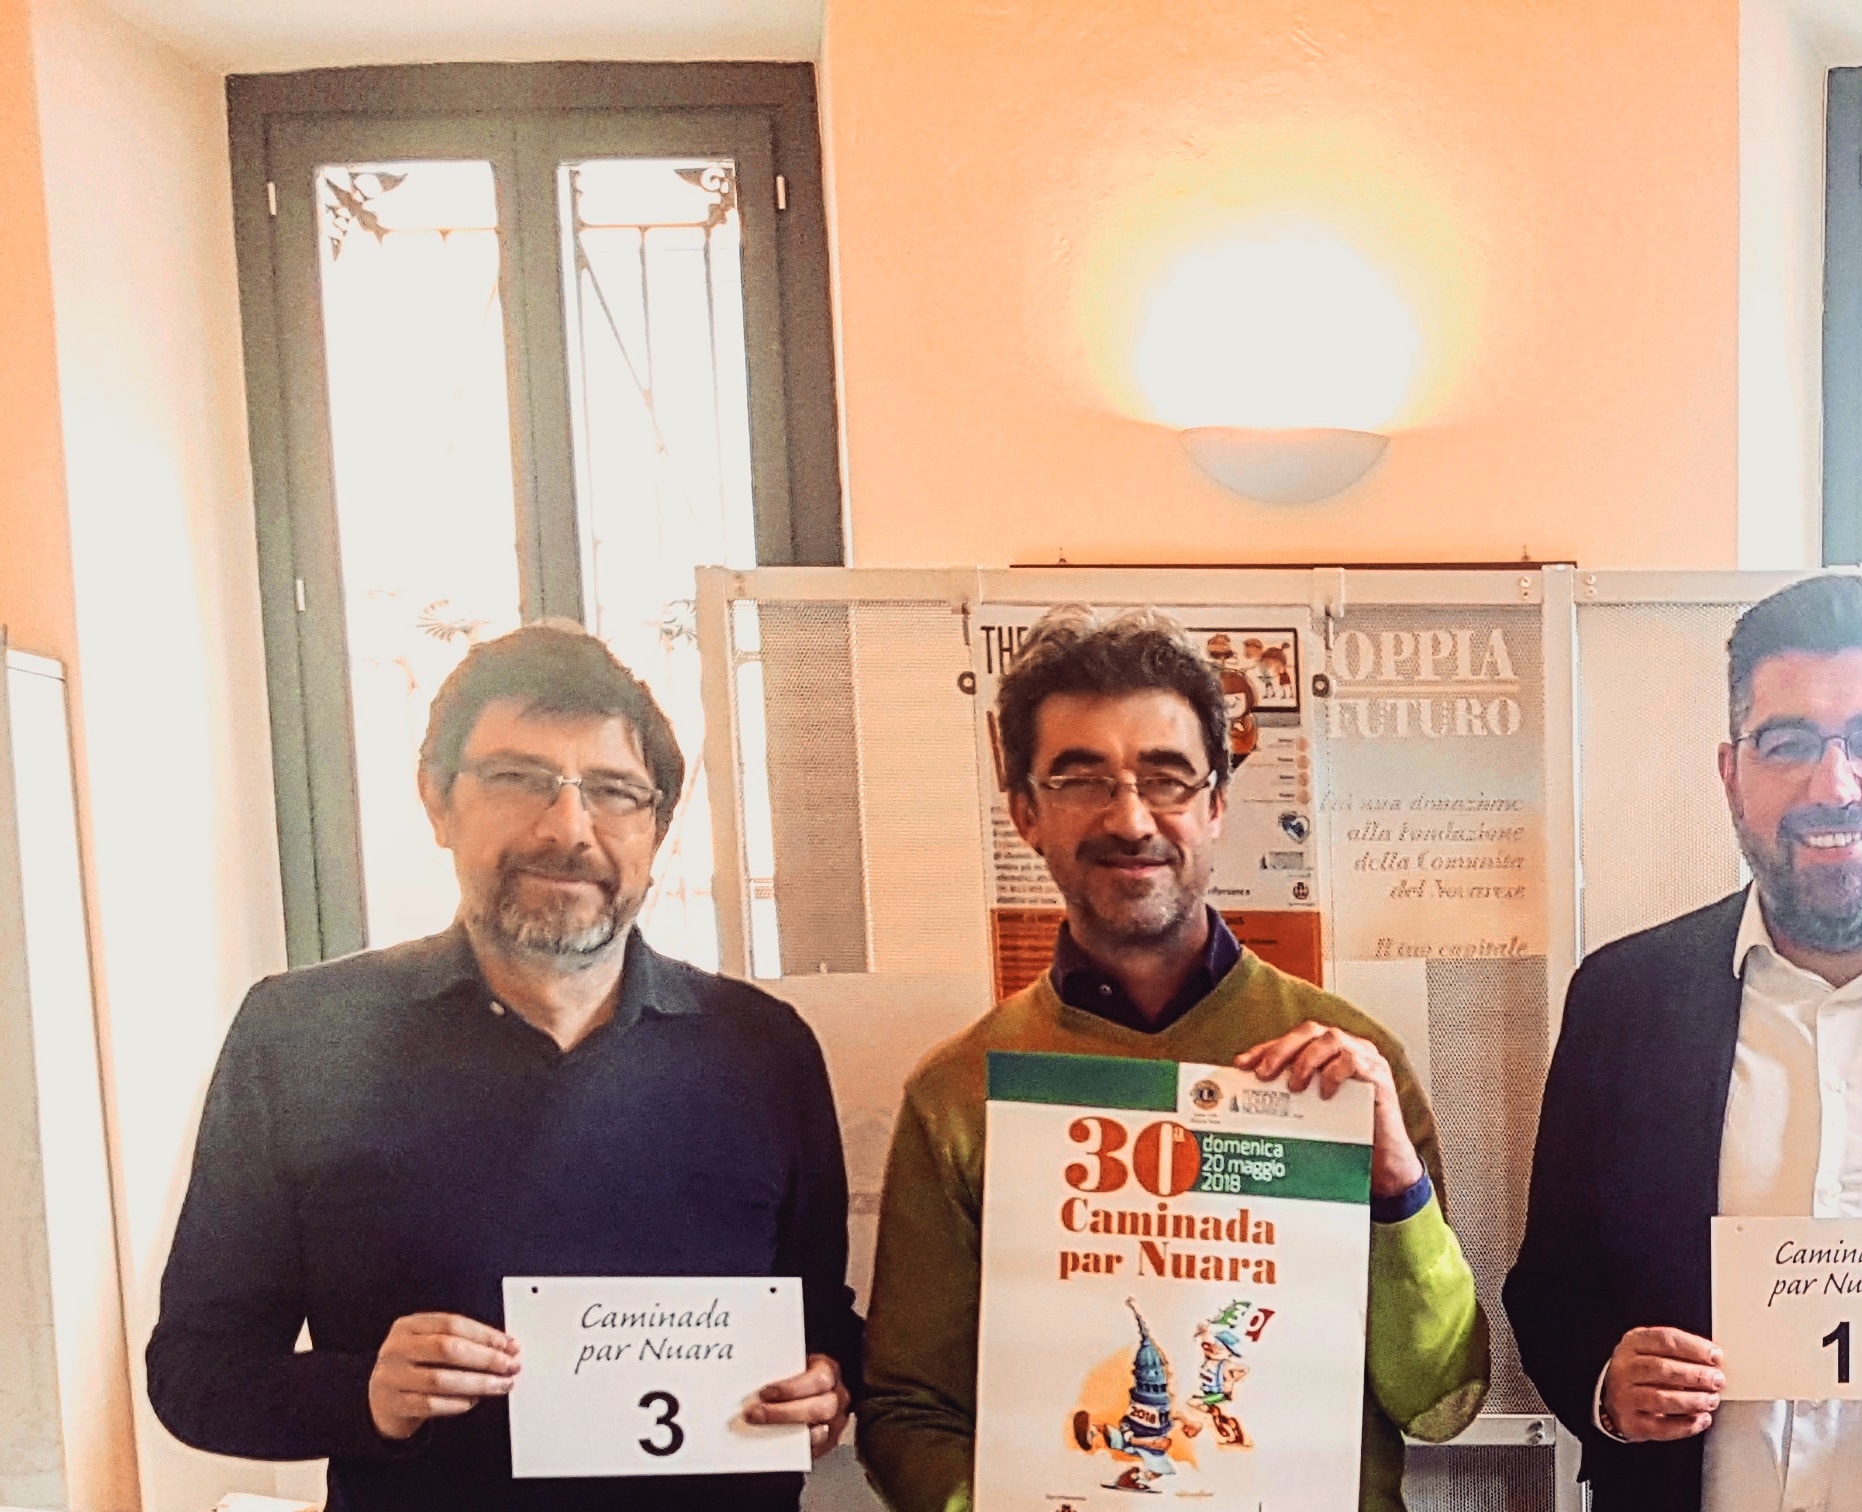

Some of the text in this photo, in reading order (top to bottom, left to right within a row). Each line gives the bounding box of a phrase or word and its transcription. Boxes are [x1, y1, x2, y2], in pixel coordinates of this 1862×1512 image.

[1328, 699, 1521, 738] FUTURO
[1203, 1134, 1284, 1159] domenica
[1200, 1174, 1242, 1193] 2018
[1202, 1153, 1286, 1182] 20 maggio
[1061, 1197, 1277, 1246] Caminada
[1059, 1240, 1278, 1285] par Nuara
[1767, 1277, 1818, 1307] par
[580, 1298, 731, 1329] Caminada
[574, 1337, 735, 1374] par Nuara
[1822, 1321, 1850, 1384] 1
[637, 1390, 684, 1457] 3
[1130, 1407, 1157, 1424] 2018
